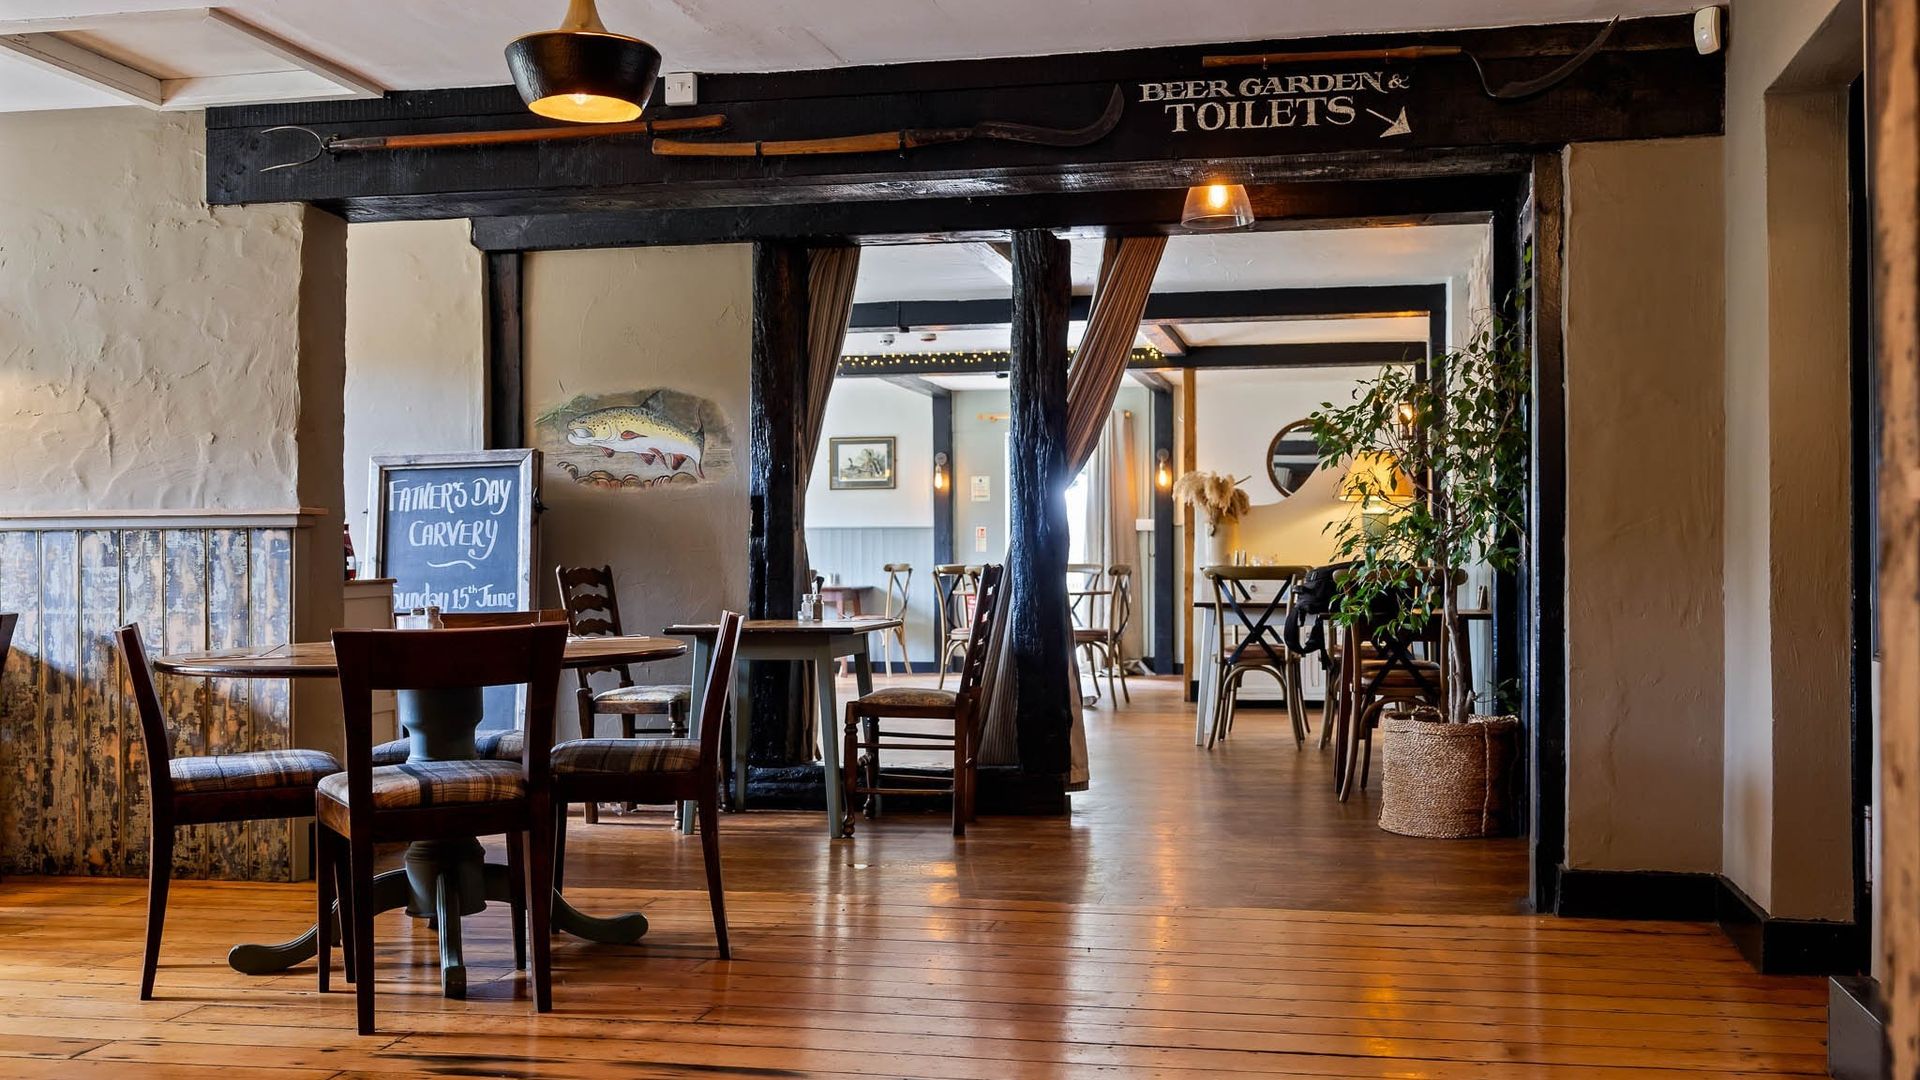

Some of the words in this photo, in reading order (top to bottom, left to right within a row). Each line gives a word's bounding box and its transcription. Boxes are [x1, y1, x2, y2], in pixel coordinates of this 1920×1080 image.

[1139, 80, 1236, 102] BEER
[1239, 71, 1388, 97] GARDEN
[1388, 73, 1410, 89] &
[1164, 95, 1356, 133] TOILETS
[470, 477, 512, 515] DAY
[408, 519, 498, 560] CARVERY
[476, 584, 516, 608] June
